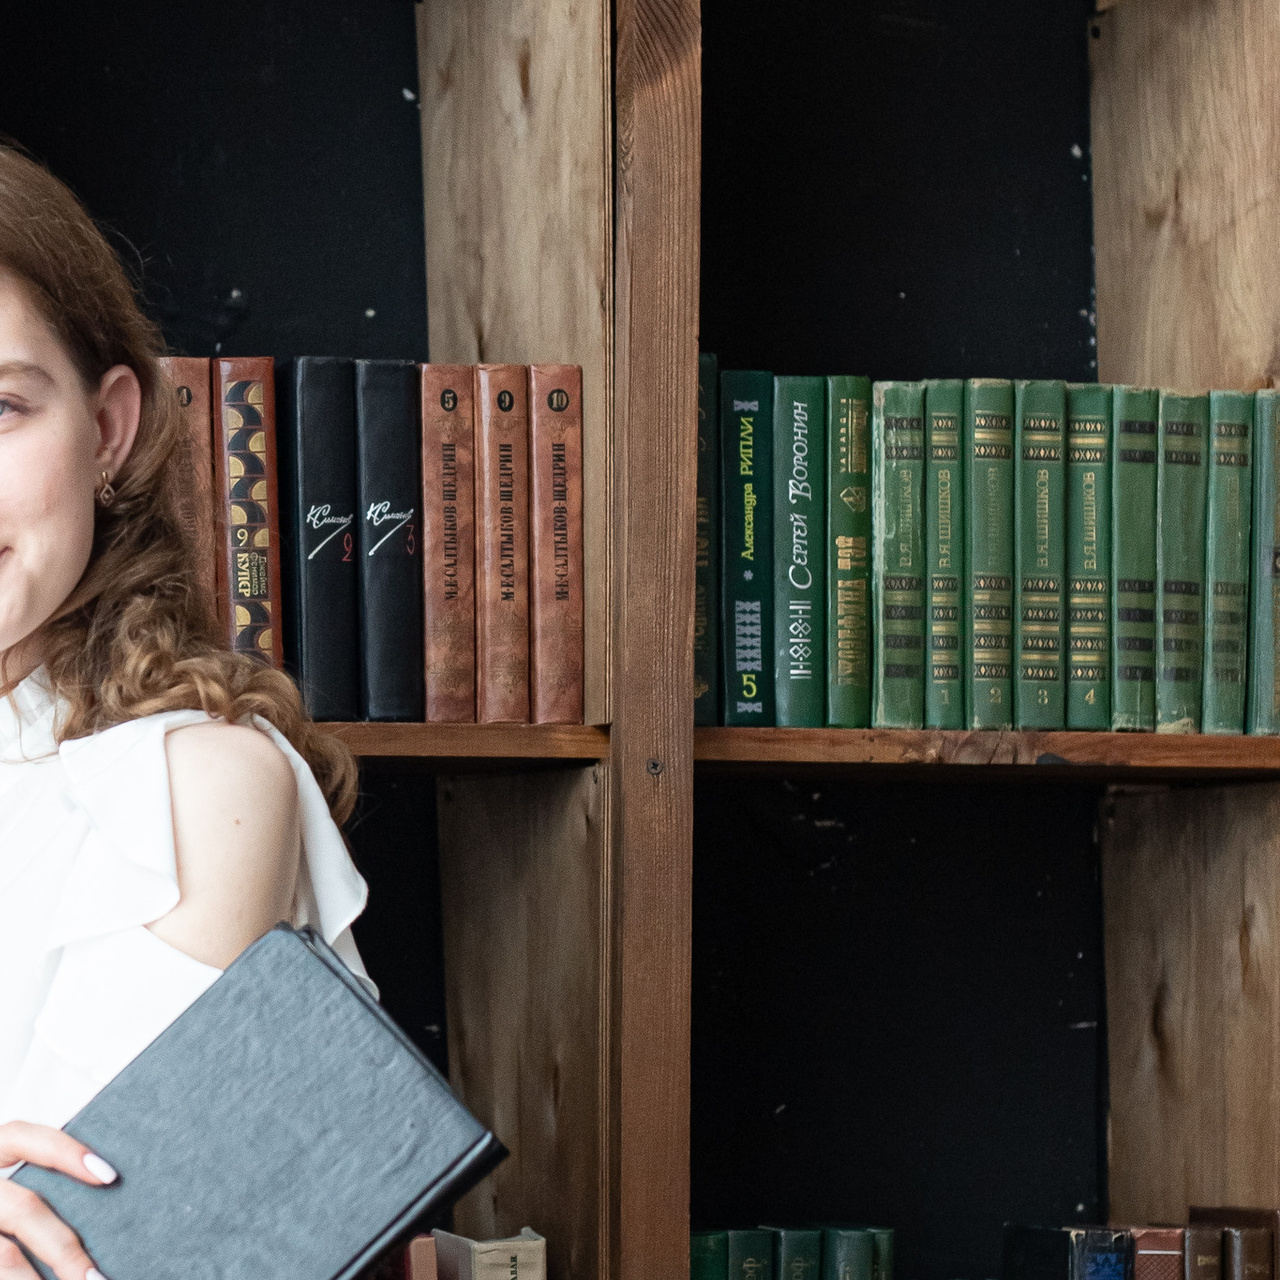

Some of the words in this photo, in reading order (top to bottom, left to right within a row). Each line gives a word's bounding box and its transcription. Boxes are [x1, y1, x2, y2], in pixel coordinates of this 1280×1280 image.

[443, 390, 456, 409] 5
[550, 389, 567, 409] 10
[739, 416, 755, 477] РИПЛИ
[740, 482, 757, 561] Александра
[1082, 469, 1097, 540] ШИШКОВ
[342, 532, 353, 562] 2
[405, 524, 416, 556] 3
[236, 552, 252, 598] КУПЕР
[251, 552, 259, 596] Фенимор
[258, 555, 268, 595] Джеймс
[742, 673, 758, 699] 5
